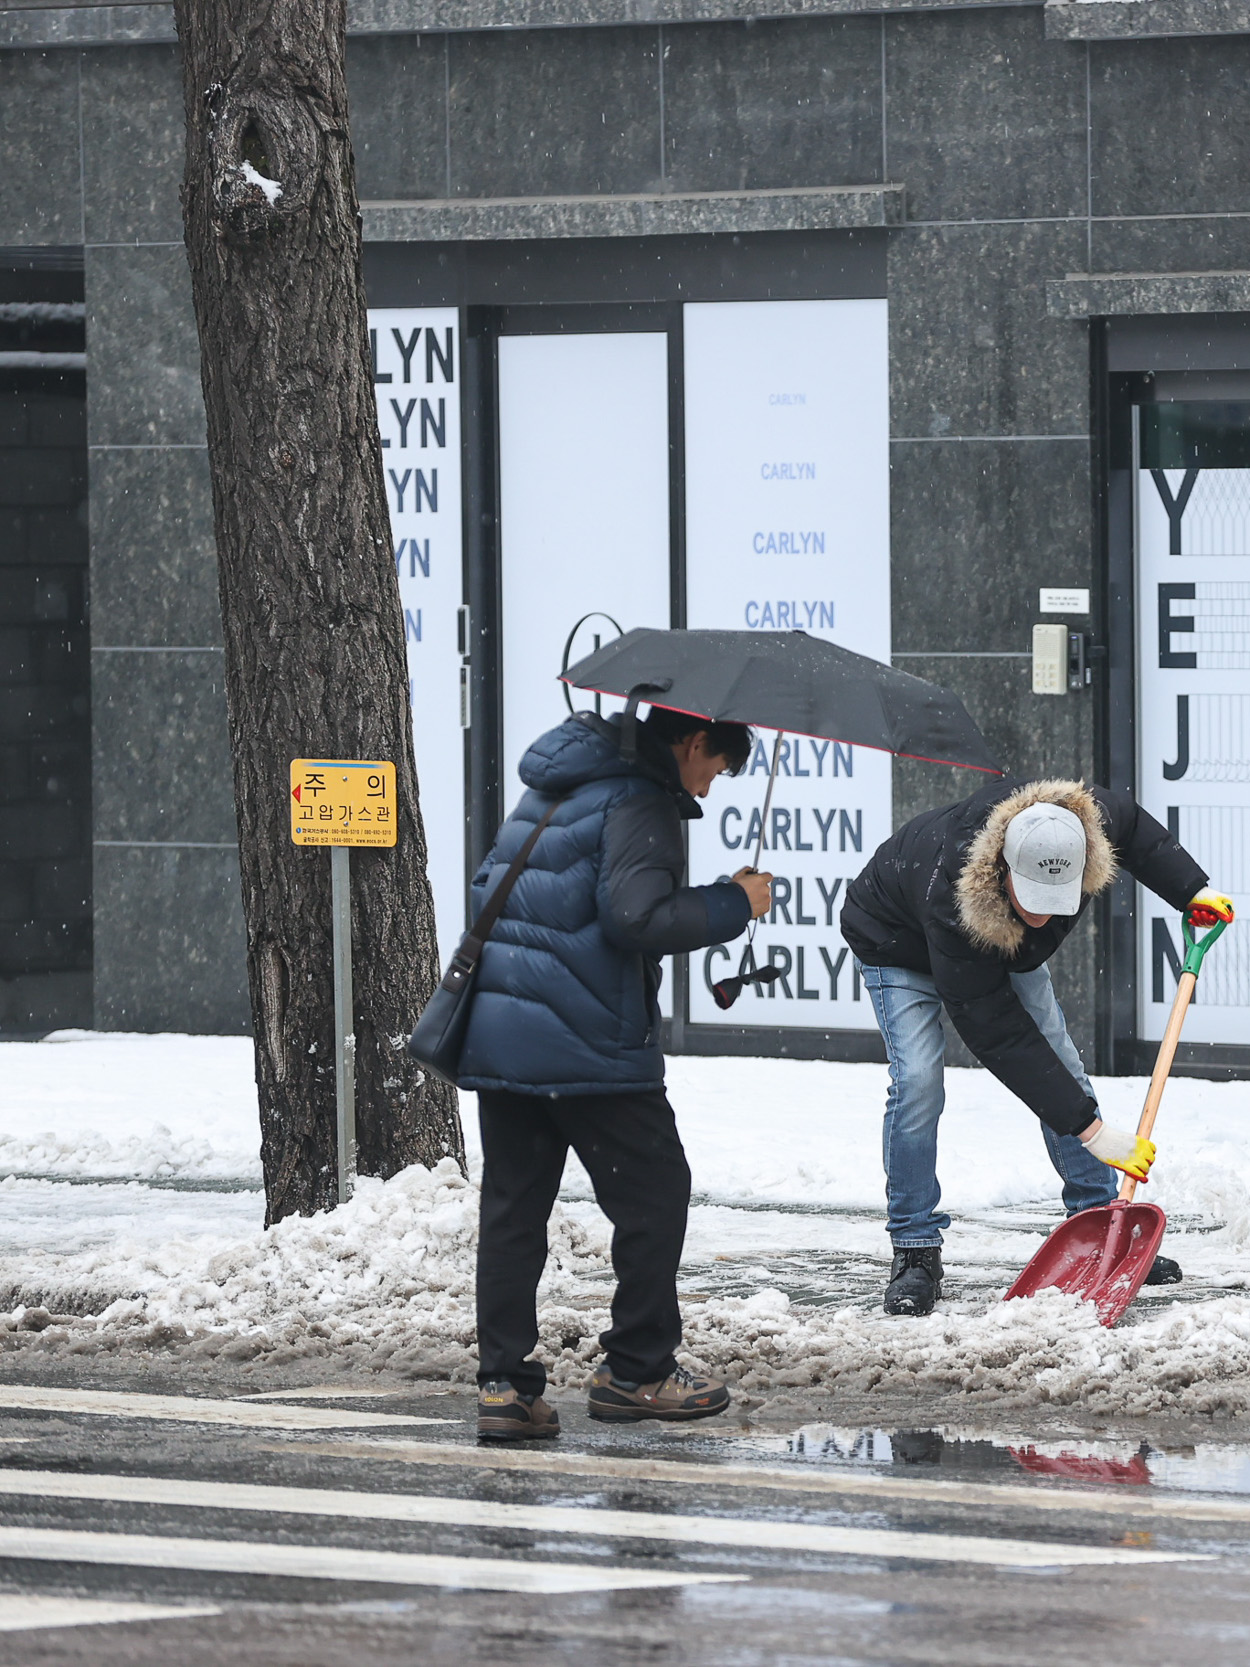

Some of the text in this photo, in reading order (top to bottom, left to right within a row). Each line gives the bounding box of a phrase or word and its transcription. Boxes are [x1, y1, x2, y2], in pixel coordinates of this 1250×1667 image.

[768, 394, 806, 406] CARLYN
[761, 463, 815, 480] CARLYN
[753, 532, 825, 554] CARLYN
[745, 600, 834, 628] CARLYN
[738, 738, 853, 778] ARLYN
[720, 806, 862, 852] CARLYN
[714, 874, 854, 926] RLY
